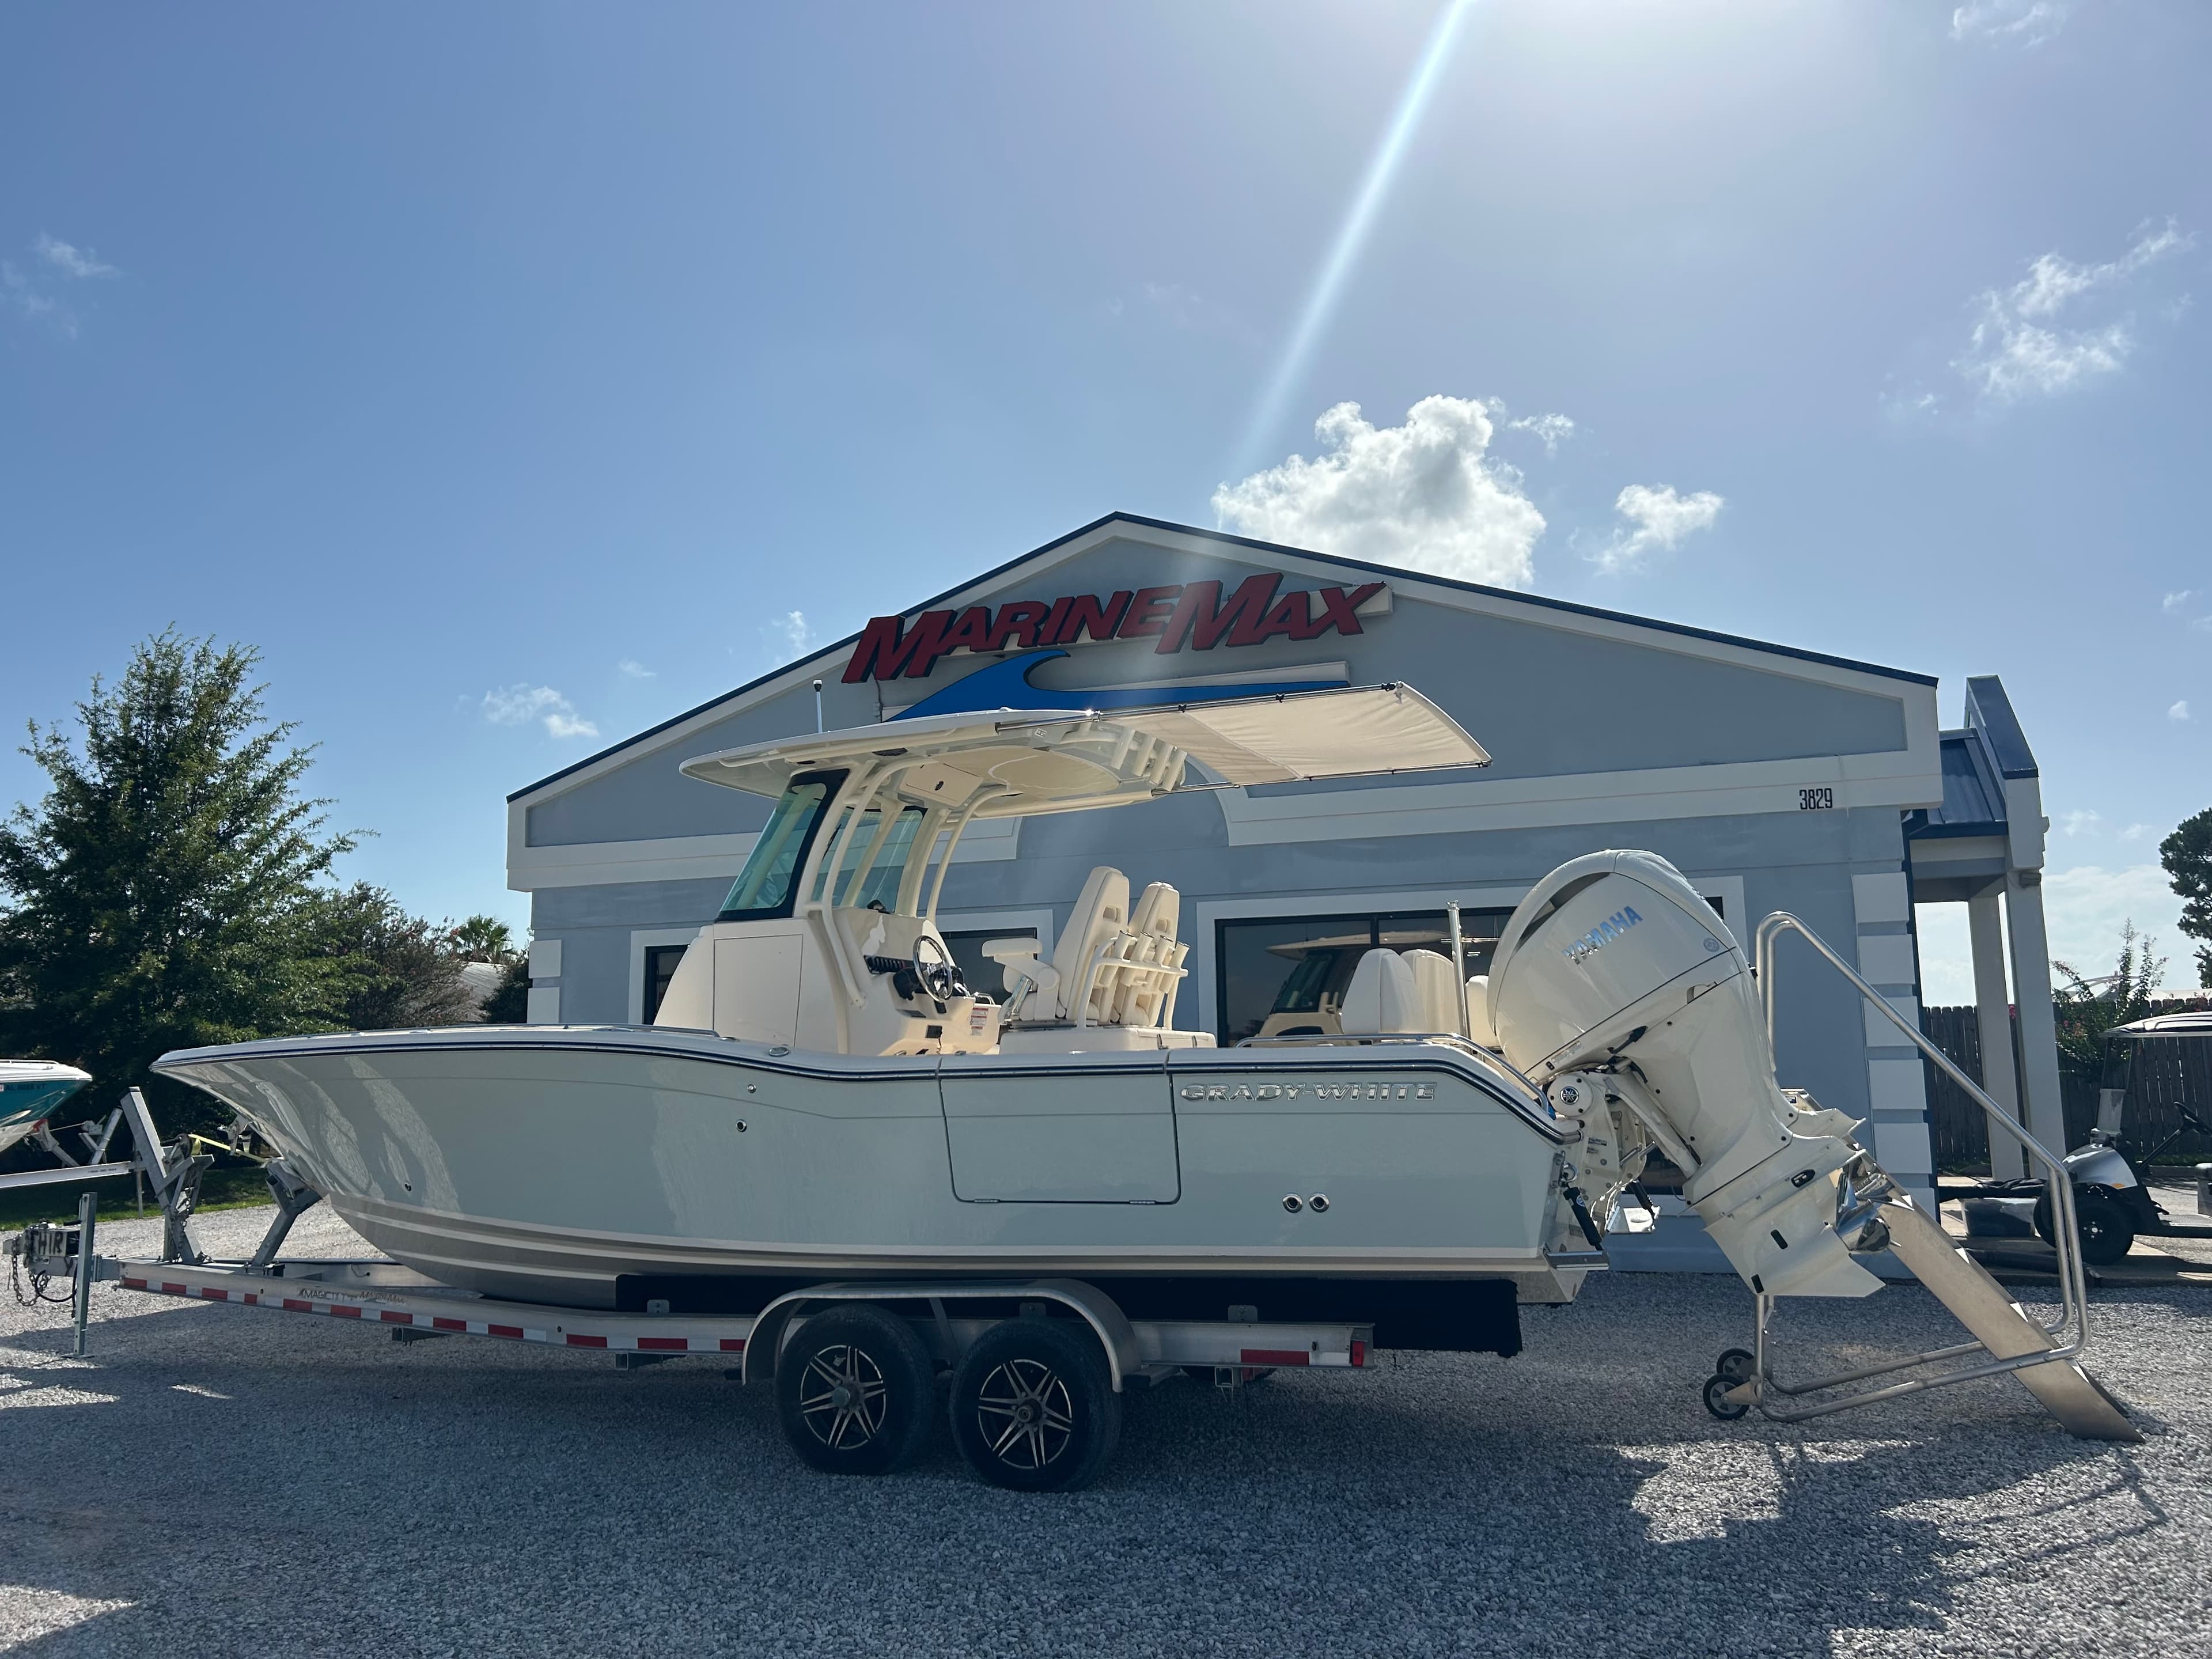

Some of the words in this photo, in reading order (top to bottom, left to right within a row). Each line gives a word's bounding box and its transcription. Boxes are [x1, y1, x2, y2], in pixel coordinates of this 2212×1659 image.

[1799, 787, 1833, 810] 3829
[1562, 905, 1644, 965] YAMAHA
[1180, 1082, 1438, 1101] GRADY-WHITE
